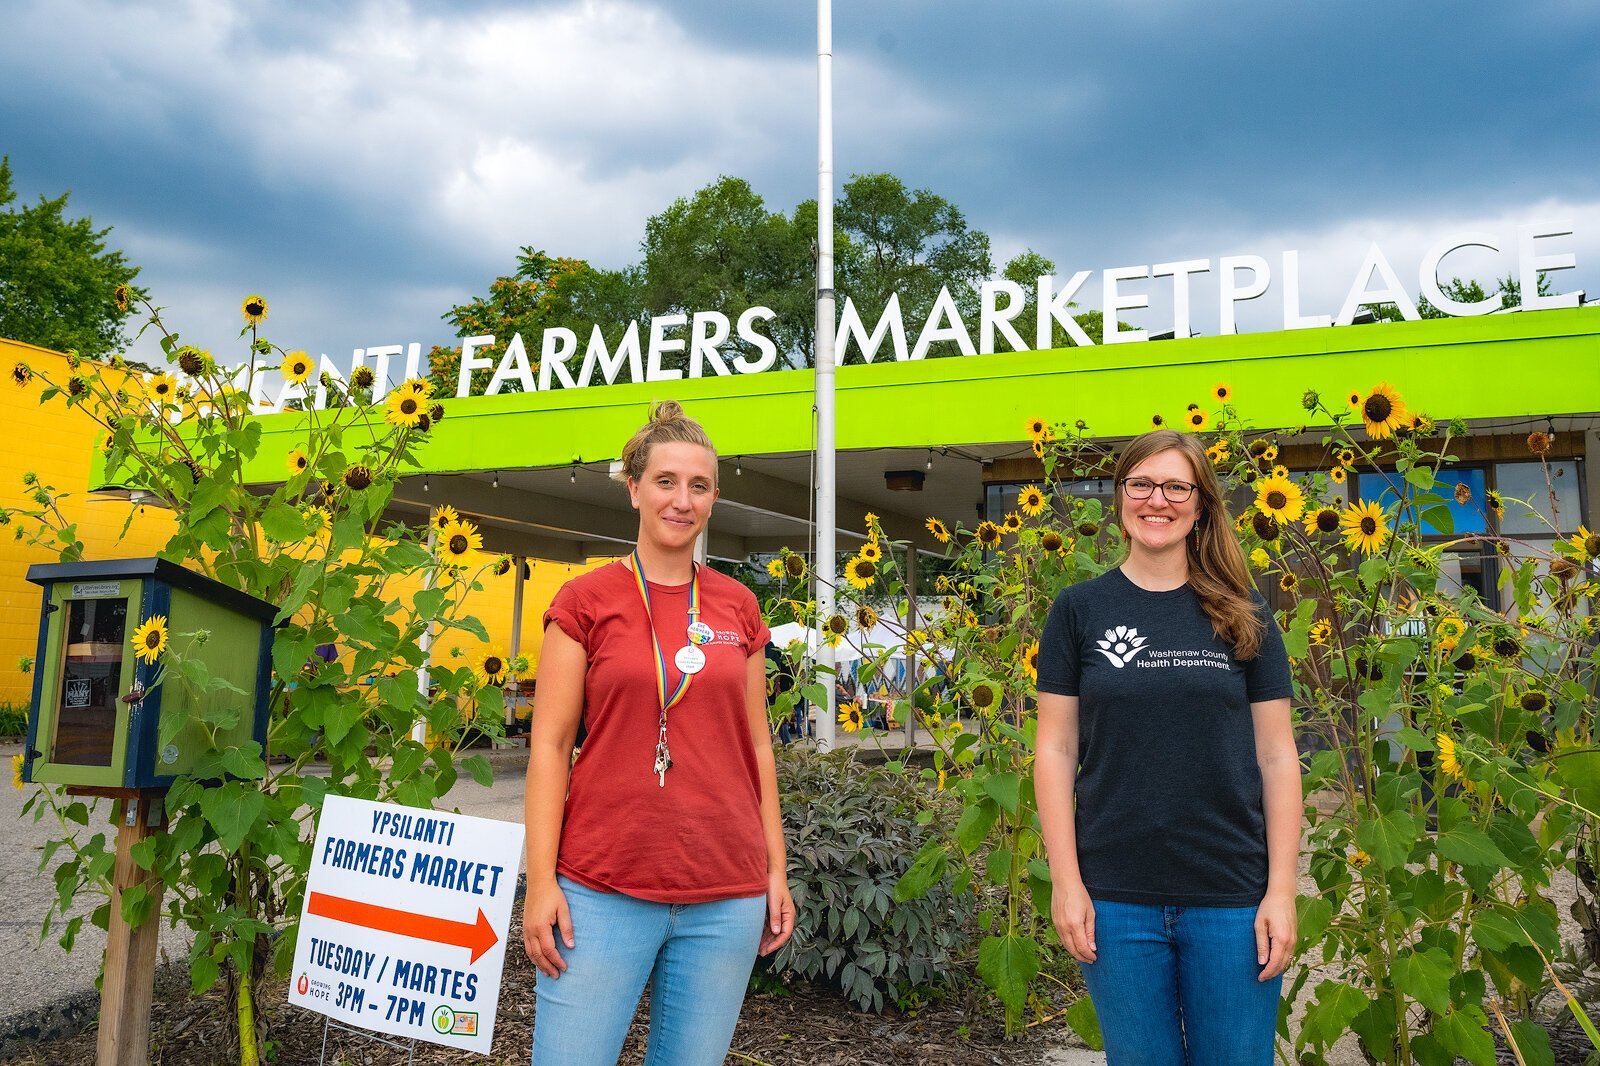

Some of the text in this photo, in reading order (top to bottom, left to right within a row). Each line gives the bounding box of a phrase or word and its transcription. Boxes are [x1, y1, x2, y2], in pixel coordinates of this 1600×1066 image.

[456, 305, 778, 398] FARMERS
[834, 222, 1582, 367] MARKETPLACE
[718, 634, 740, 642] HOPE
[1137, 659, 1230, 670] Health Department
[1148, 649, 1229, 663] Washtenaw County
[371, 810, 455, 847] YPSILANTI
[322, 836, 504, 898] FARMERS MARKET
[309, 937, 478, 1002] TUESDAY / MARTES
[309, 986, 331, 1002] HOPE
[310, 979, 332, 991] GROWING
[335, 981, 366, 1014] 3PM
[385, 994, 426, 1027] 7PM
